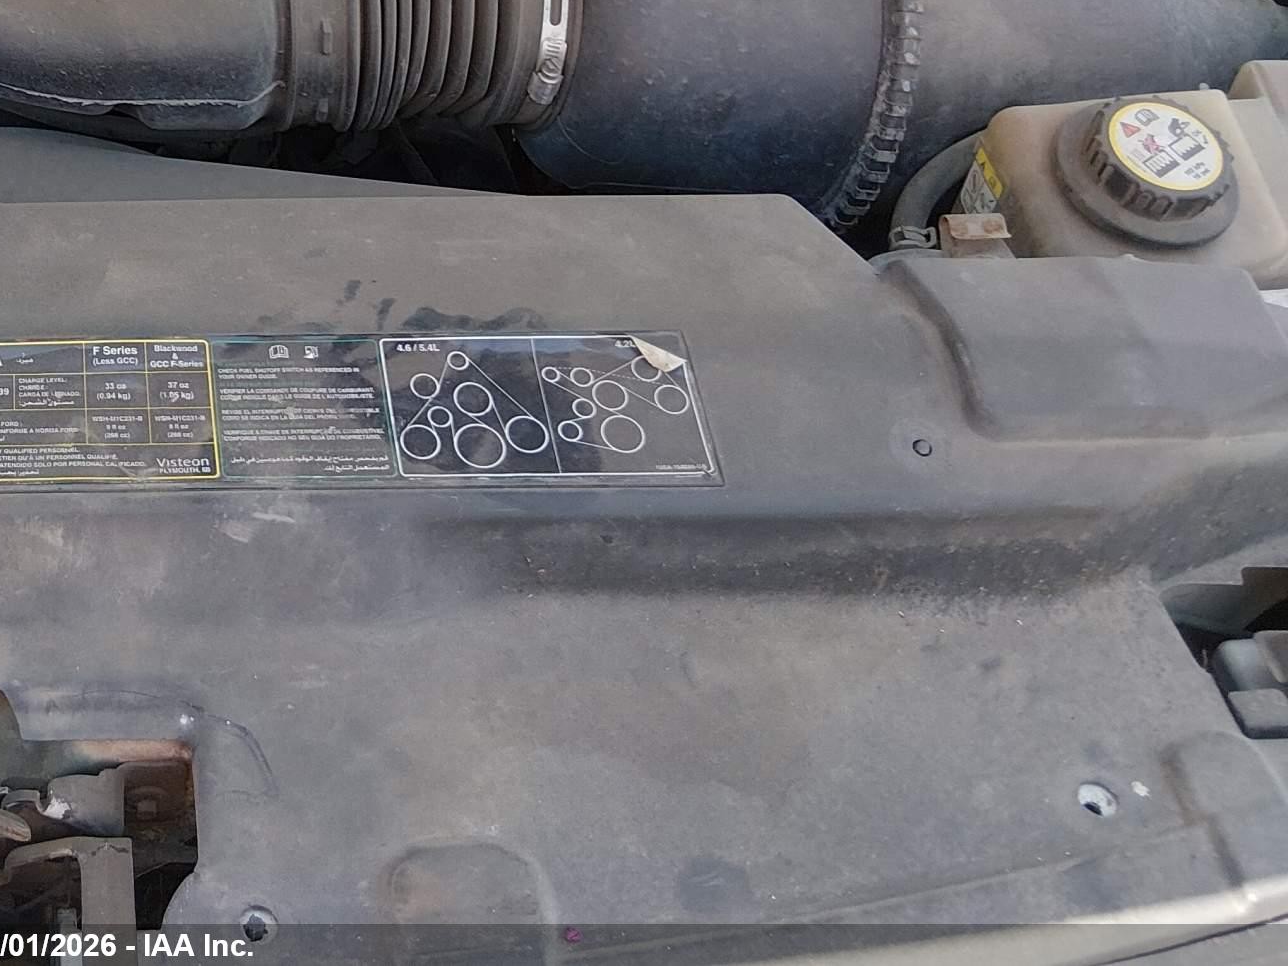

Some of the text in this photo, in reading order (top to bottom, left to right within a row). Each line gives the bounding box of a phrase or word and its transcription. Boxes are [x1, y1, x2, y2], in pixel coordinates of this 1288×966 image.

[93, 345, 138, 356] F Series
[153, 344, 198, 352] Blackwood
[396, 343, 412, 352] 4.6
[418, 343, 441, 352] 5.4L
[93, 357, 139, 367] (Less GCC)
[149, 359, 204, 369] GCC F-Series
[167, 381, 178, 389] 37
[156, 457, 210, 468] Visteon
